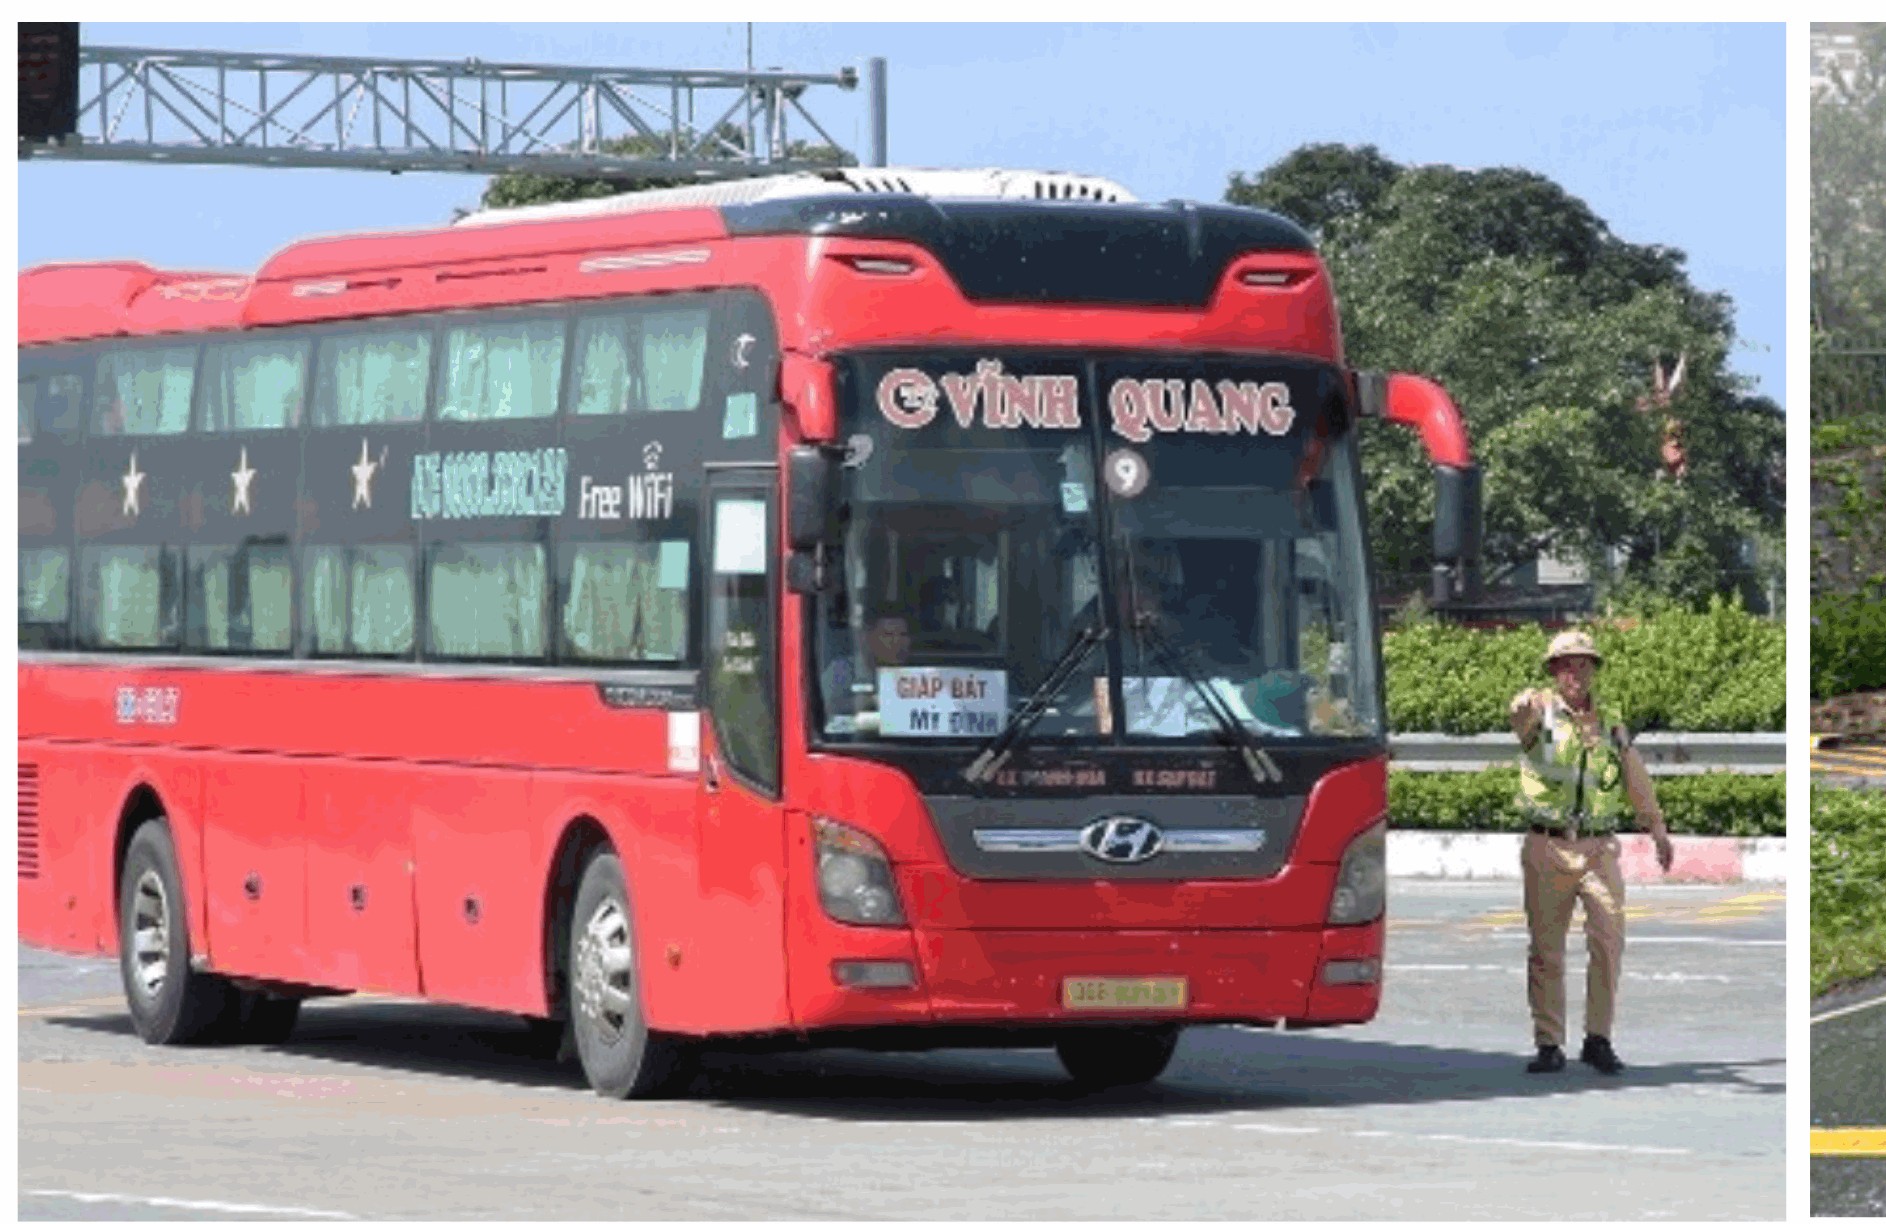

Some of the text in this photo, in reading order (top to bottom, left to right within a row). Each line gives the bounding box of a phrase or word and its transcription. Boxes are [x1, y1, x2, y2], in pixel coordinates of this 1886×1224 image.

[942, 357, 1296, 443] VĨNH QUANG
[578, 475, 622, 519] Free
[629, 471, 674, 519] WiFi
[1115, 455, 1140, 492] 9
